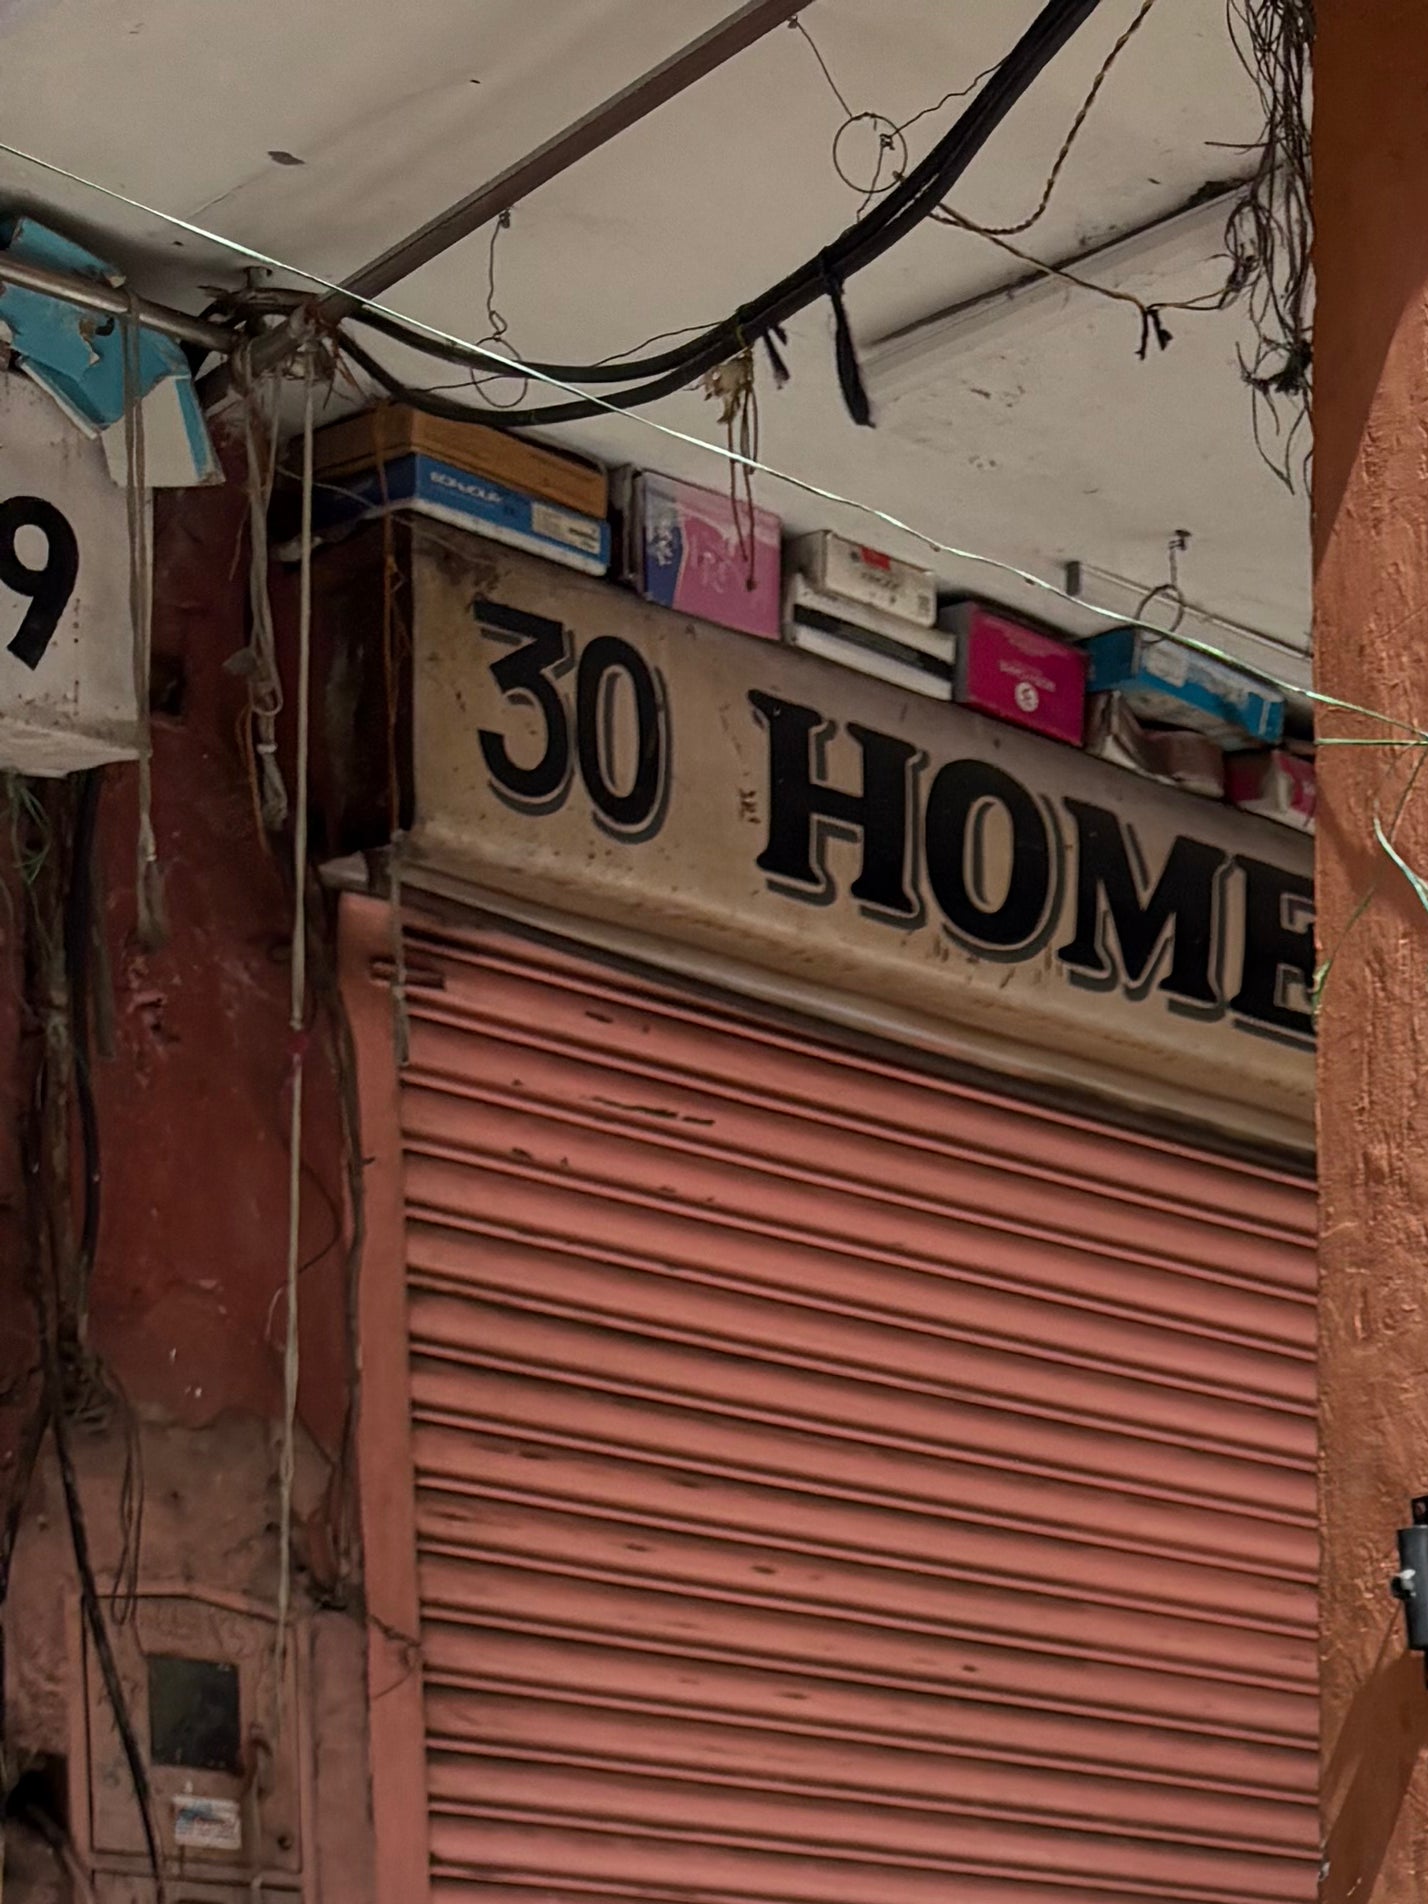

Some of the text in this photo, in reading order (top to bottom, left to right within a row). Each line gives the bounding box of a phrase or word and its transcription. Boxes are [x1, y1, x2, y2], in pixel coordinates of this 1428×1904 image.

[0, 496, 79, 671] 9
[473, 599, 1316, 1050] 30 HOME
